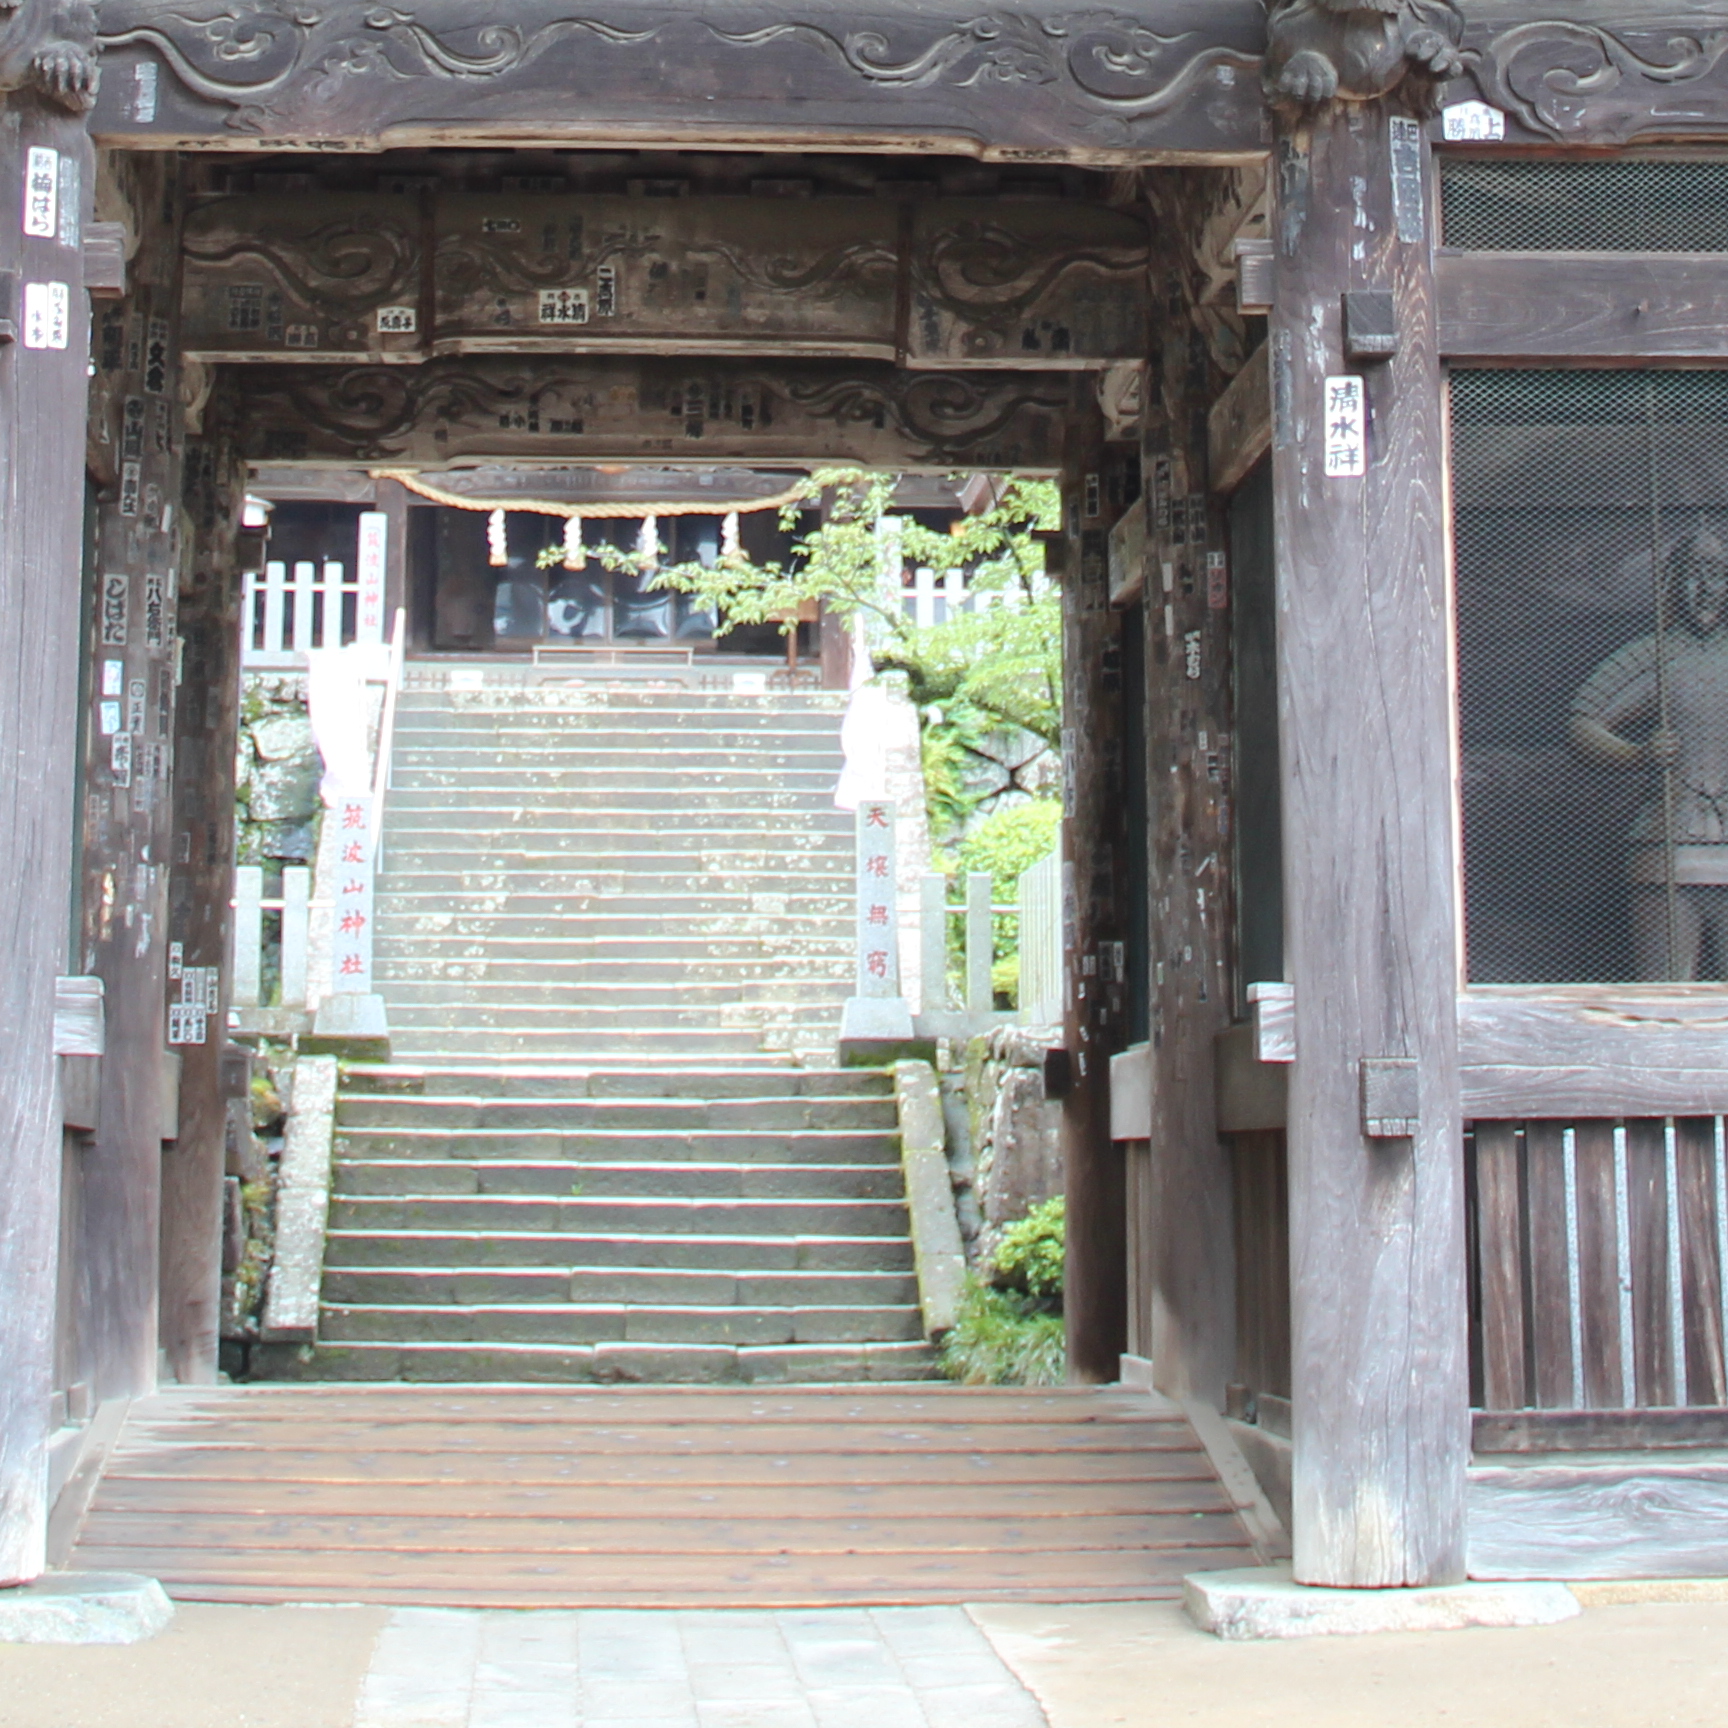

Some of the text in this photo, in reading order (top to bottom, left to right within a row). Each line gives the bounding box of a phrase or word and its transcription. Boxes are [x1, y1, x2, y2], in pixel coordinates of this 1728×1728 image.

[1329, 379, 1360, 473] 清水祥
[338, 803, 367, 976] 筑波山神社
